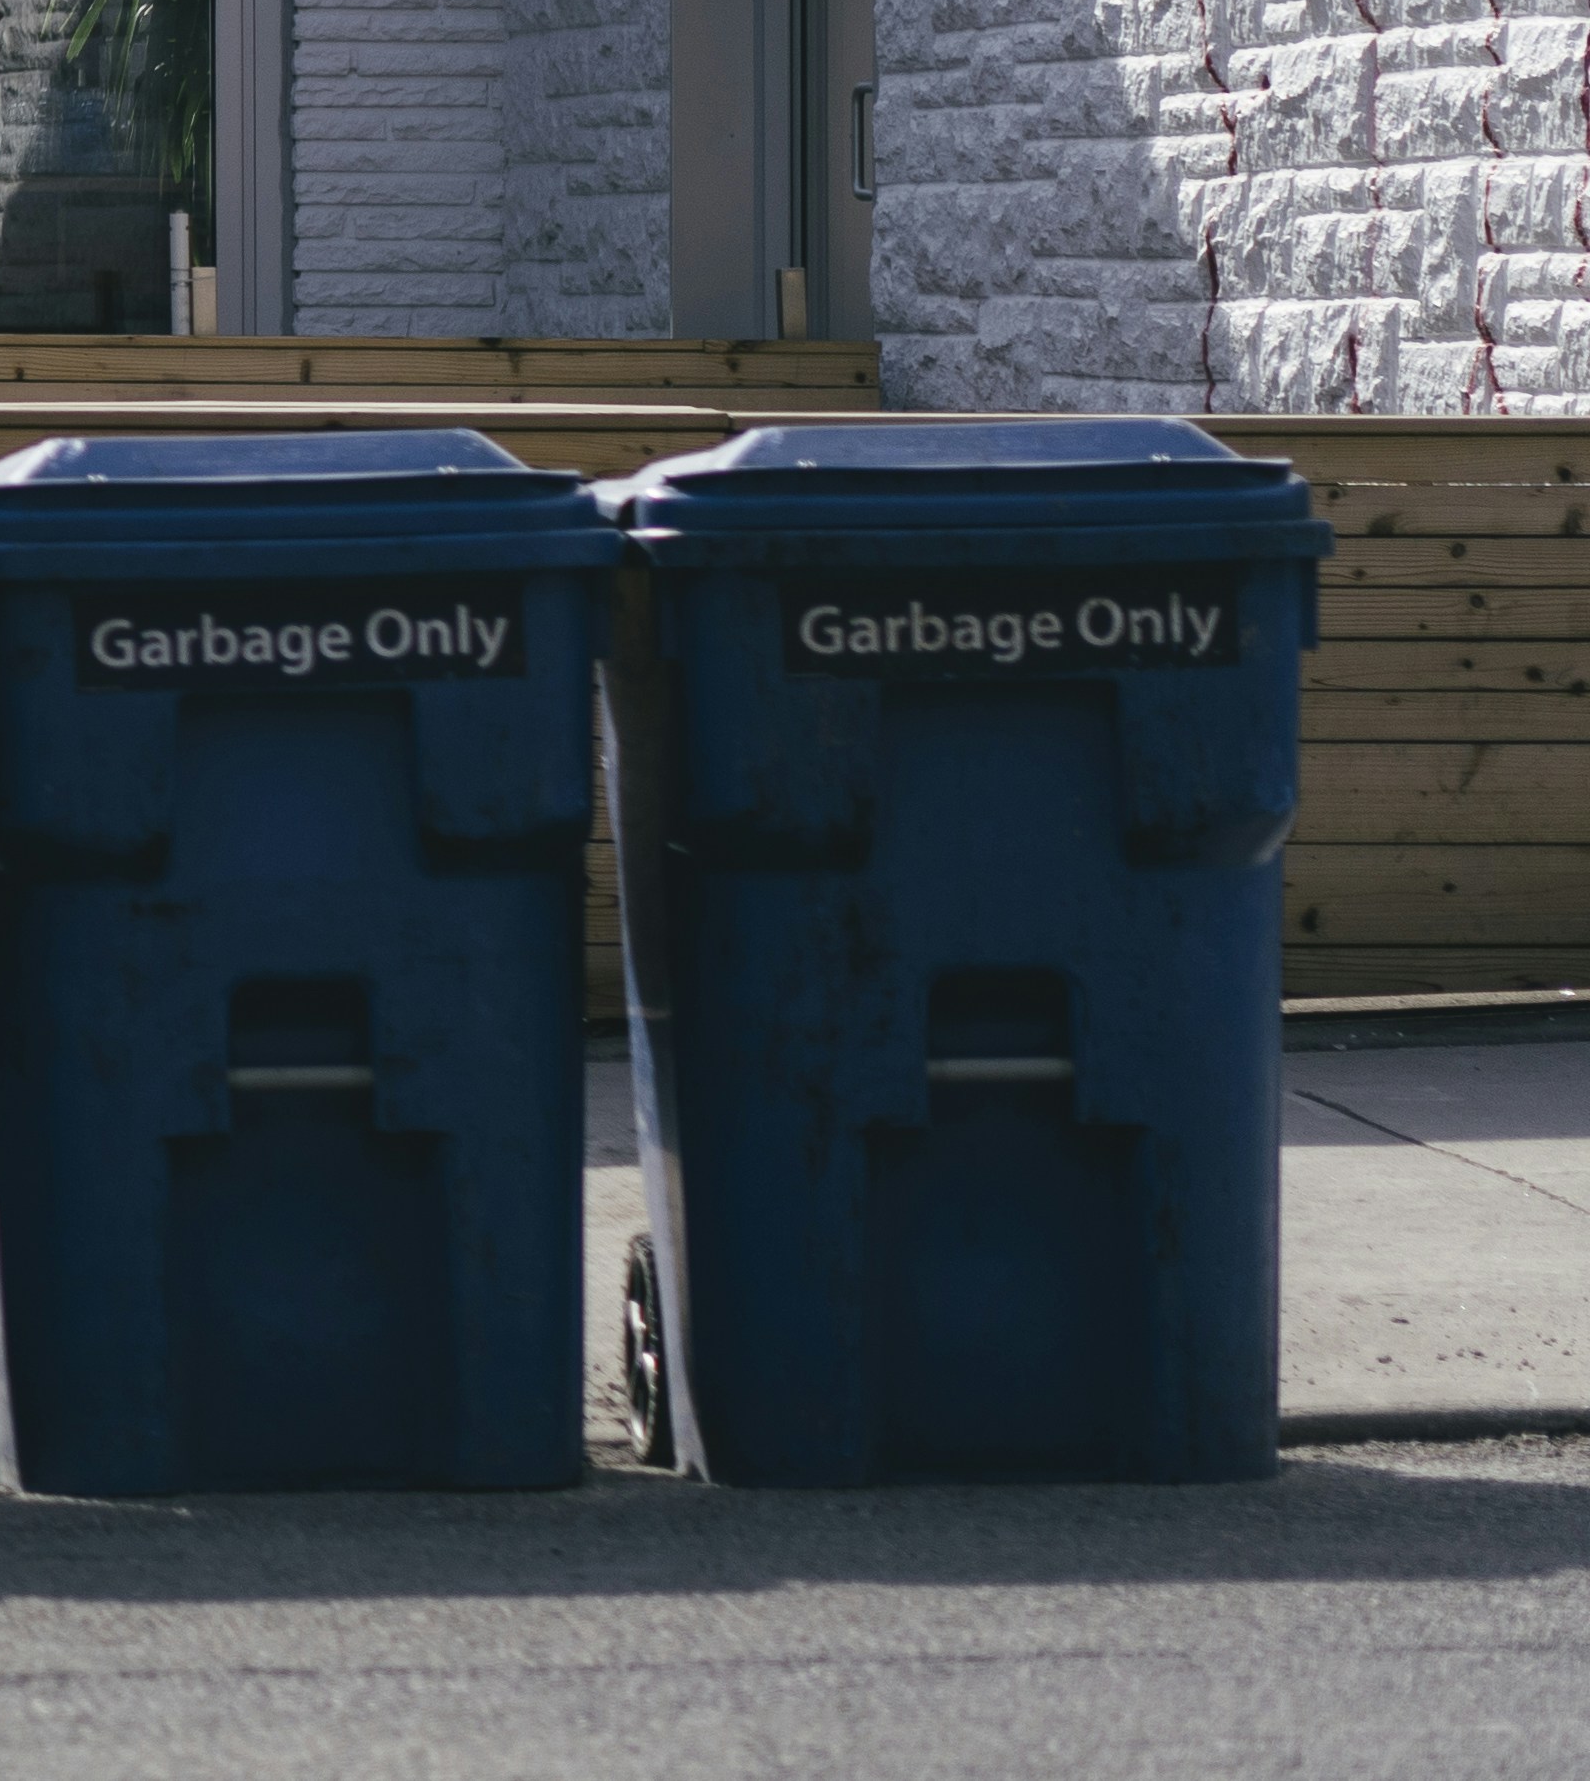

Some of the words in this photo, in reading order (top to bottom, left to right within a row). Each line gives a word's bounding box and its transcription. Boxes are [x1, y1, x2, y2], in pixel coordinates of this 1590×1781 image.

[90, 613, 353, 676] Garbage
[365, 604, 509, 668] Only
[799, 601, 1063, 663] Garbage
[1077, 592, 1222, 657] Only
